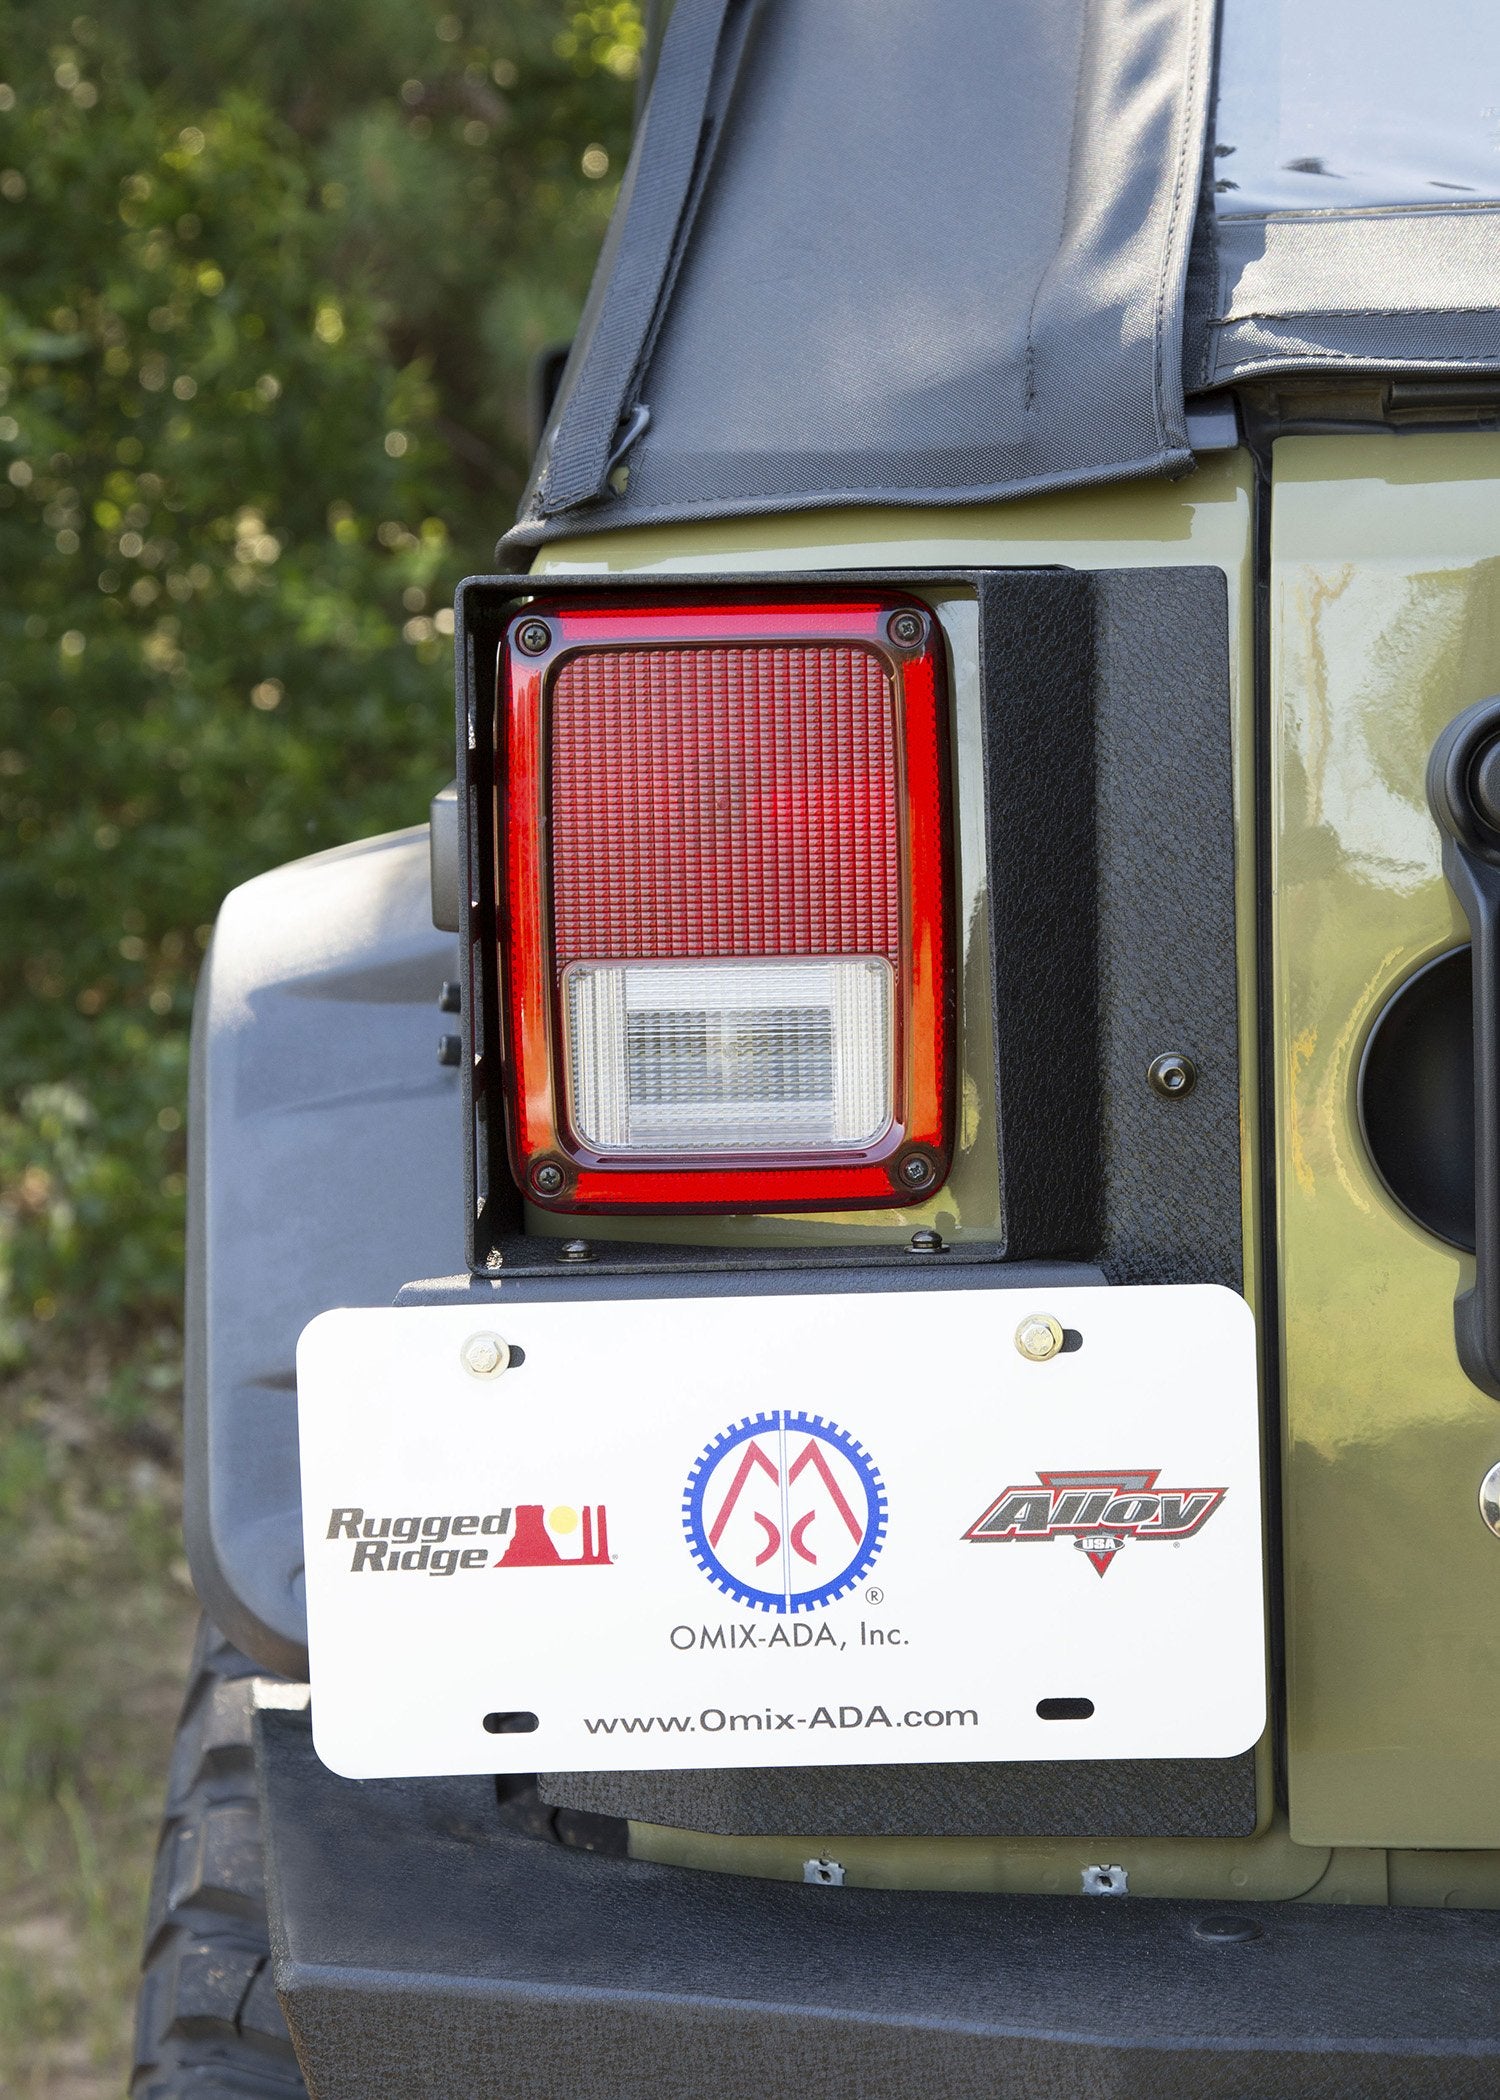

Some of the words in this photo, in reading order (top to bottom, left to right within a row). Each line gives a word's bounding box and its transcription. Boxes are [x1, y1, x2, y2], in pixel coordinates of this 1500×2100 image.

[326, 1507, 512, 1544] Rugged
[973, 1489, 1216, 1533] Alloy
[350, 1540, 489, 1577] Ridge
[1081, 1537, 1117, 1550] USA
[670, 1621, 847, 1651] OMIX-ADA,
[860, 1621, 909, 1646] Inc.
[583, 1705, 979, 1735] www.Omix-ADA.com
